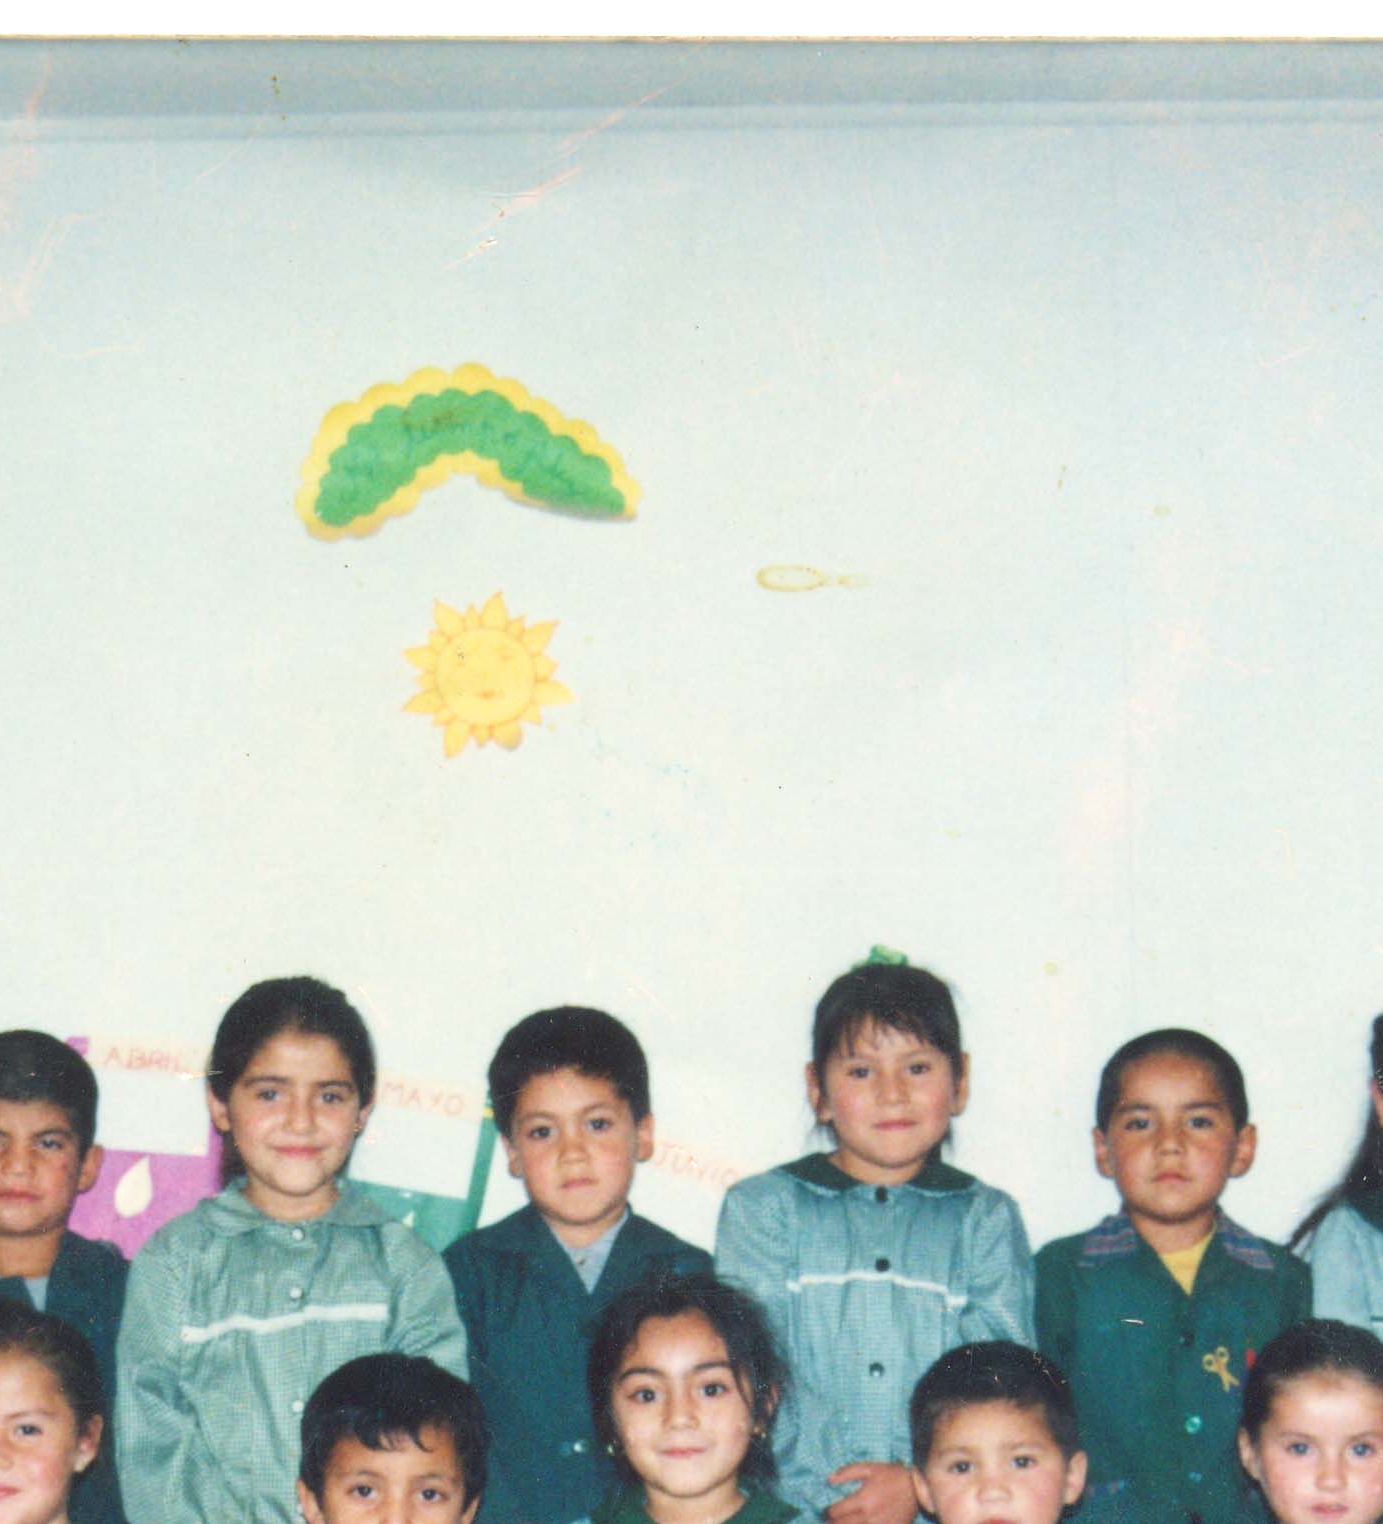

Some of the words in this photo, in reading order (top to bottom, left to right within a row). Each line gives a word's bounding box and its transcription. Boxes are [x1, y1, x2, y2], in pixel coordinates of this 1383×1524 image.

[105, 1046, 190, 1073] ABRIL
[381, 1081, 464, 1114] MAYO
[653, 1140, 737, 1188] JUNIO
